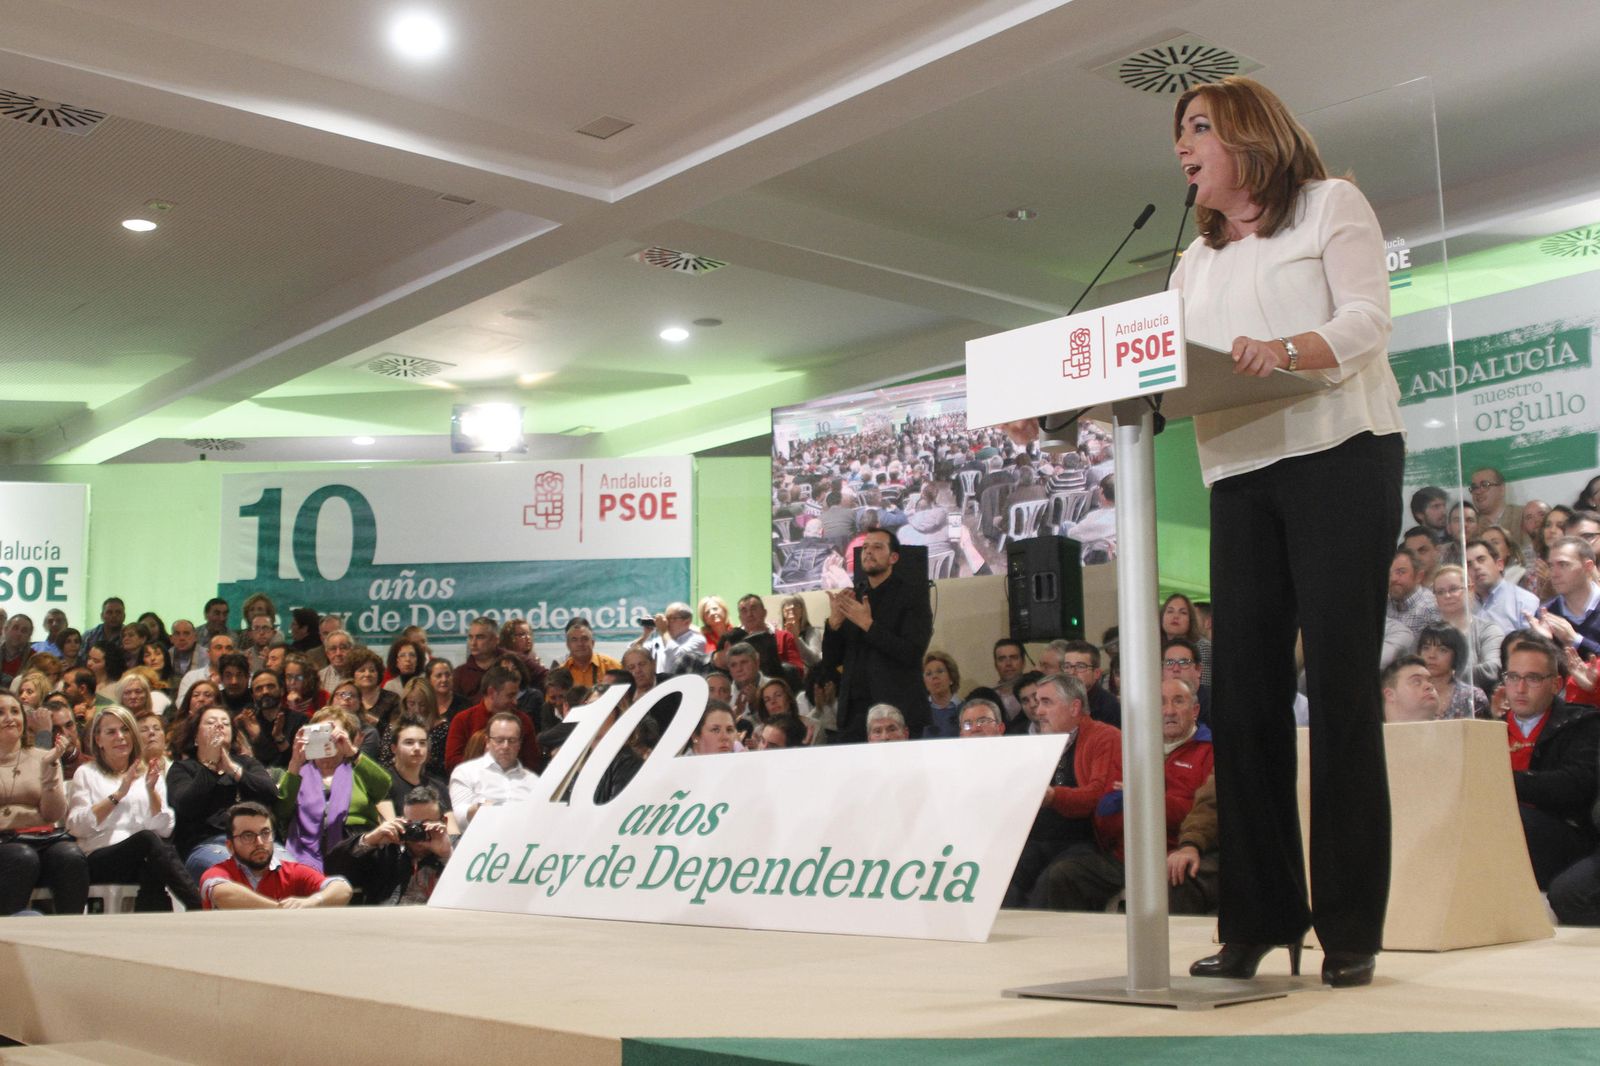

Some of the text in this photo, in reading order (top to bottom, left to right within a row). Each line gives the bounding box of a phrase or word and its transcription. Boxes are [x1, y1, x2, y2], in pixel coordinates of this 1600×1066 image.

[1115, 313, 1169, 336] Andalucía
[1116, 330, 1175, 367] PSOE
[1410, 337, 1578, 396] ANDALUCÍA
[1473, 381, 1543, 406] nuestro
[1475, 391, 1586, 431] orgullo
[600, 472, 672, 489] Andalucía
[599, 492, 677, 521] PSOE
[239, 484, 377, 582] 10
[368, 569, 456, 601] años
[358, 605, 401, 632] de
[534, 673, 709, 806] 10
[618, 790, 729, 836] años
[466, 843, 981, 905] de Ley de Dependencia
